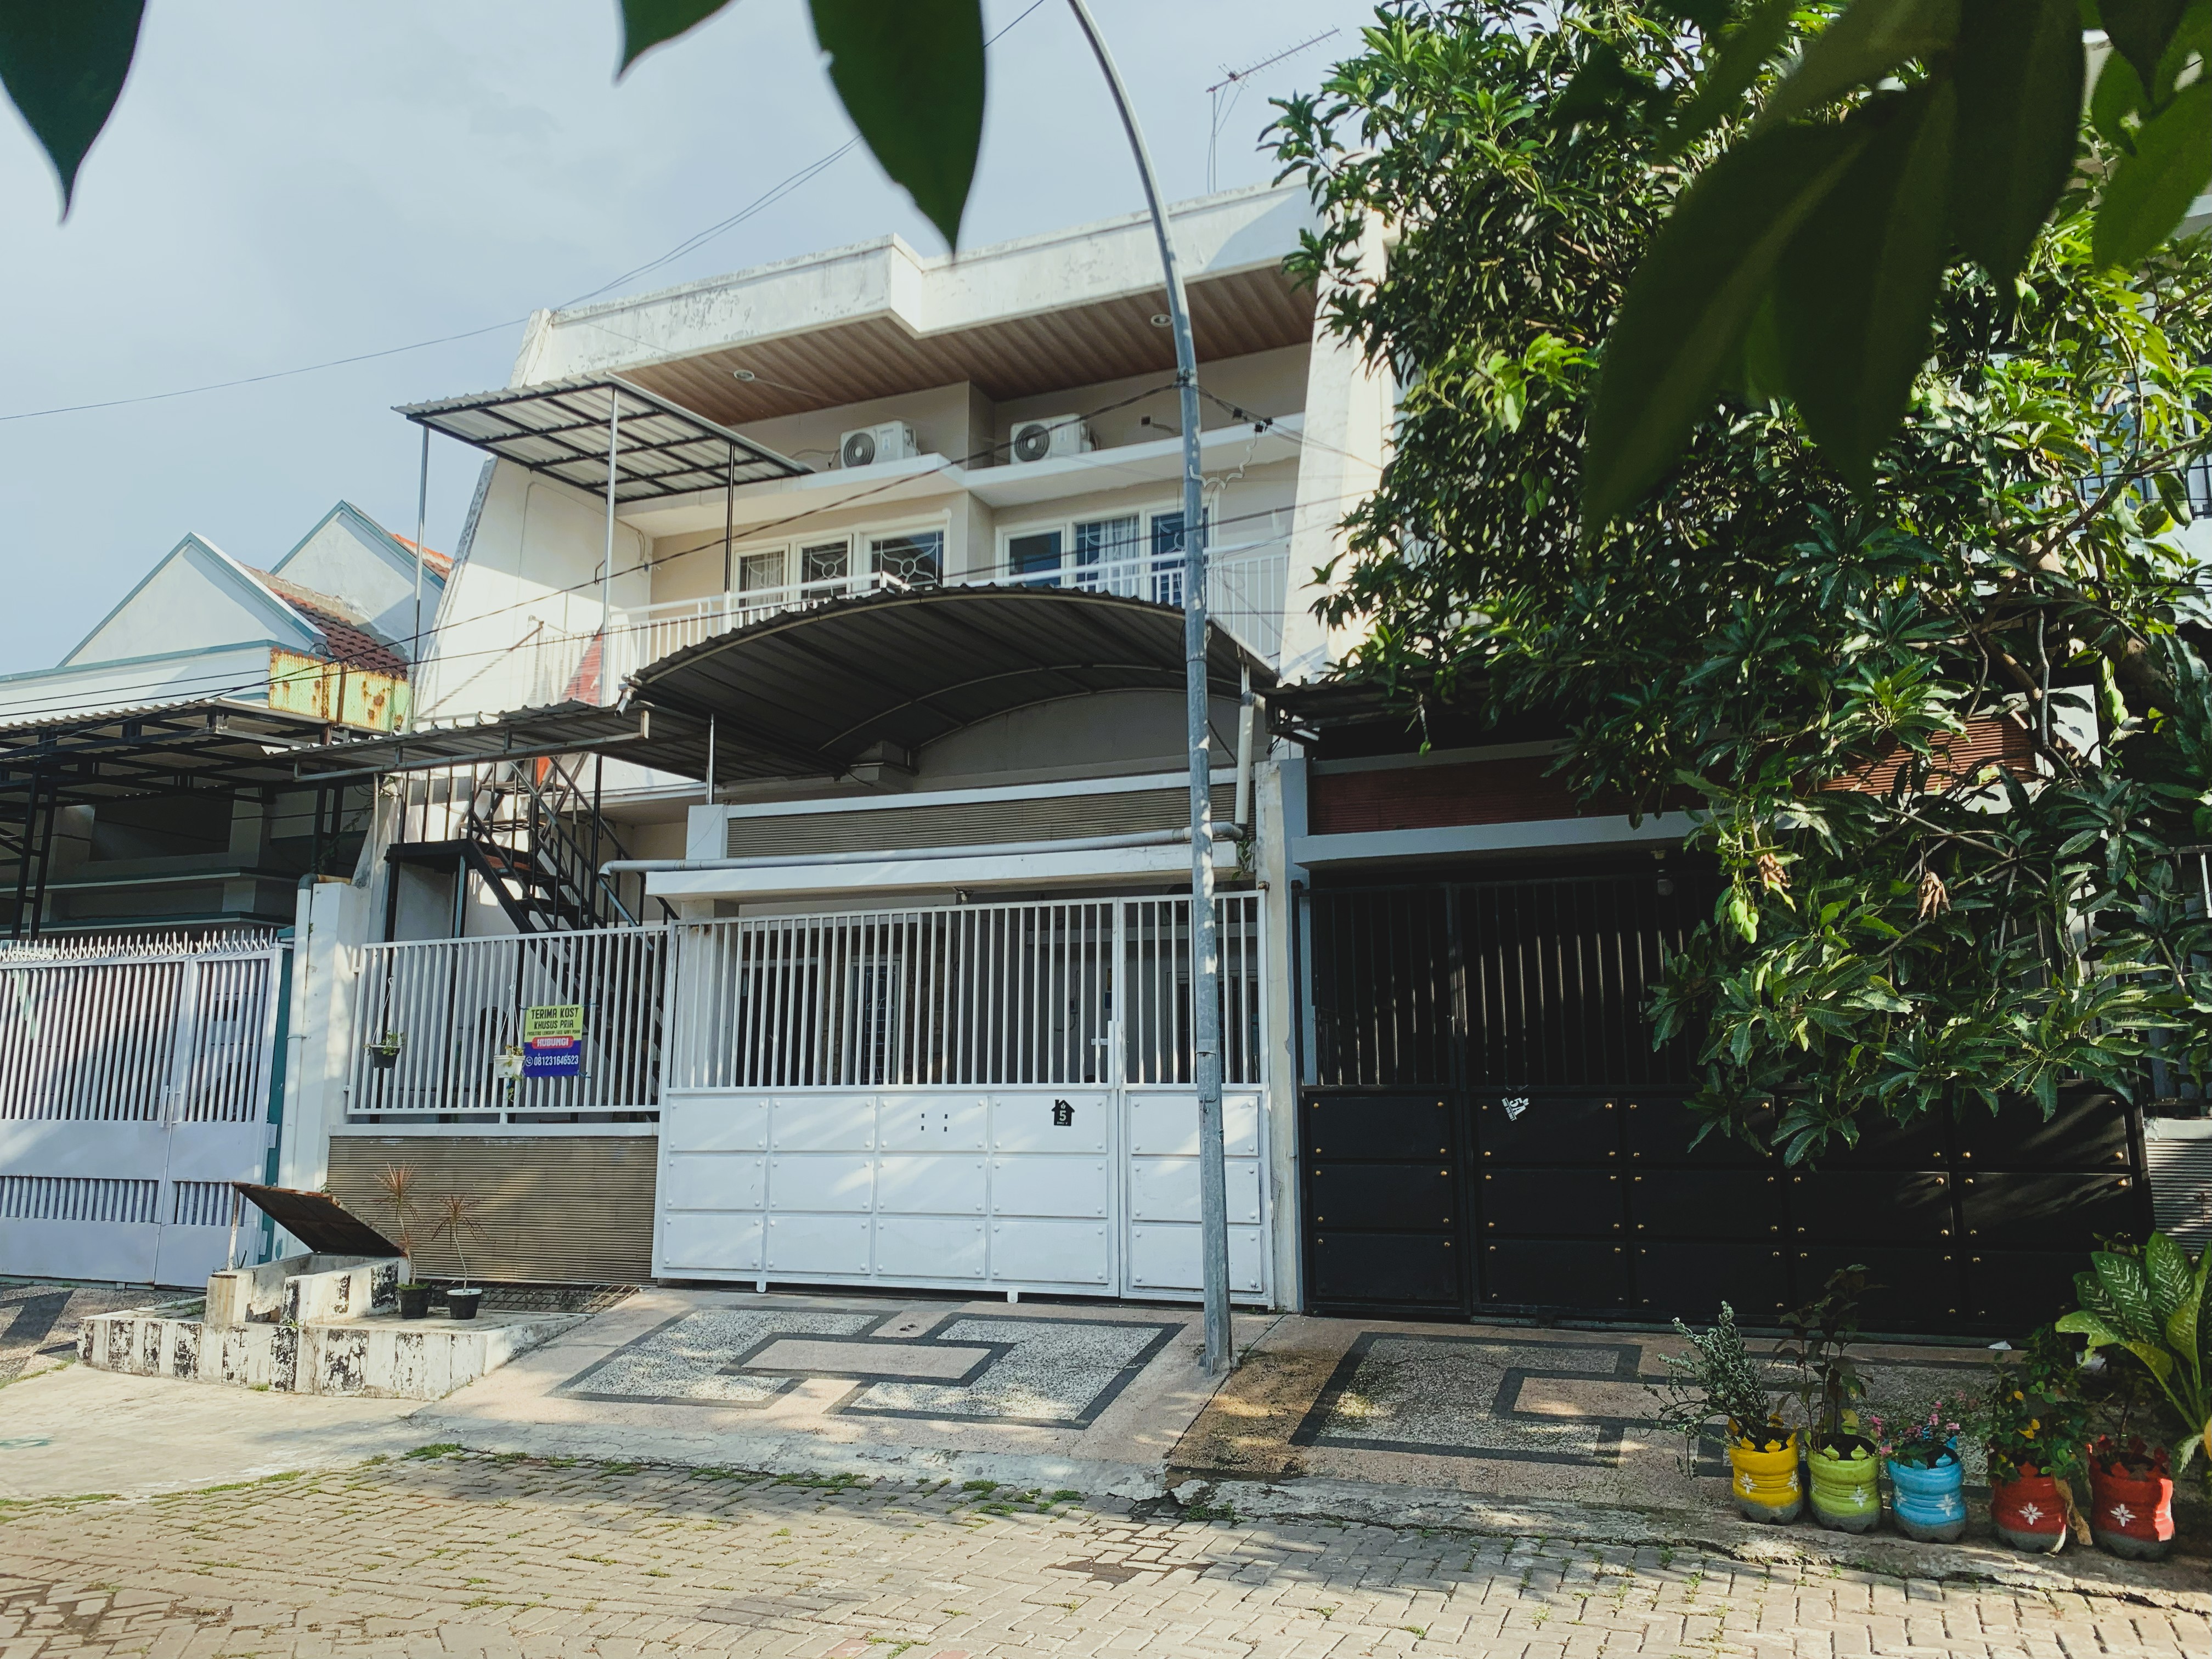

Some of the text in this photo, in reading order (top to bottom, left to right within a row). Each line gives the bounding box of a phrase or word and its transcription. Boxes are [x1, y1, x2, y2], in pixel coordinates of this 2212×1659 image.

[531, 1007, 579, 1019] TERIMA KOST
[534, 1019, 573, 1029] KHUSUS PRIA
[537, 1037, 569, 1047] HUBUNGI
[534, 1055, 579, 1066] 081231646523
[1509, 1097, 1526, 1116] 5A
[1059, 1110, 1066, 1121] 5
